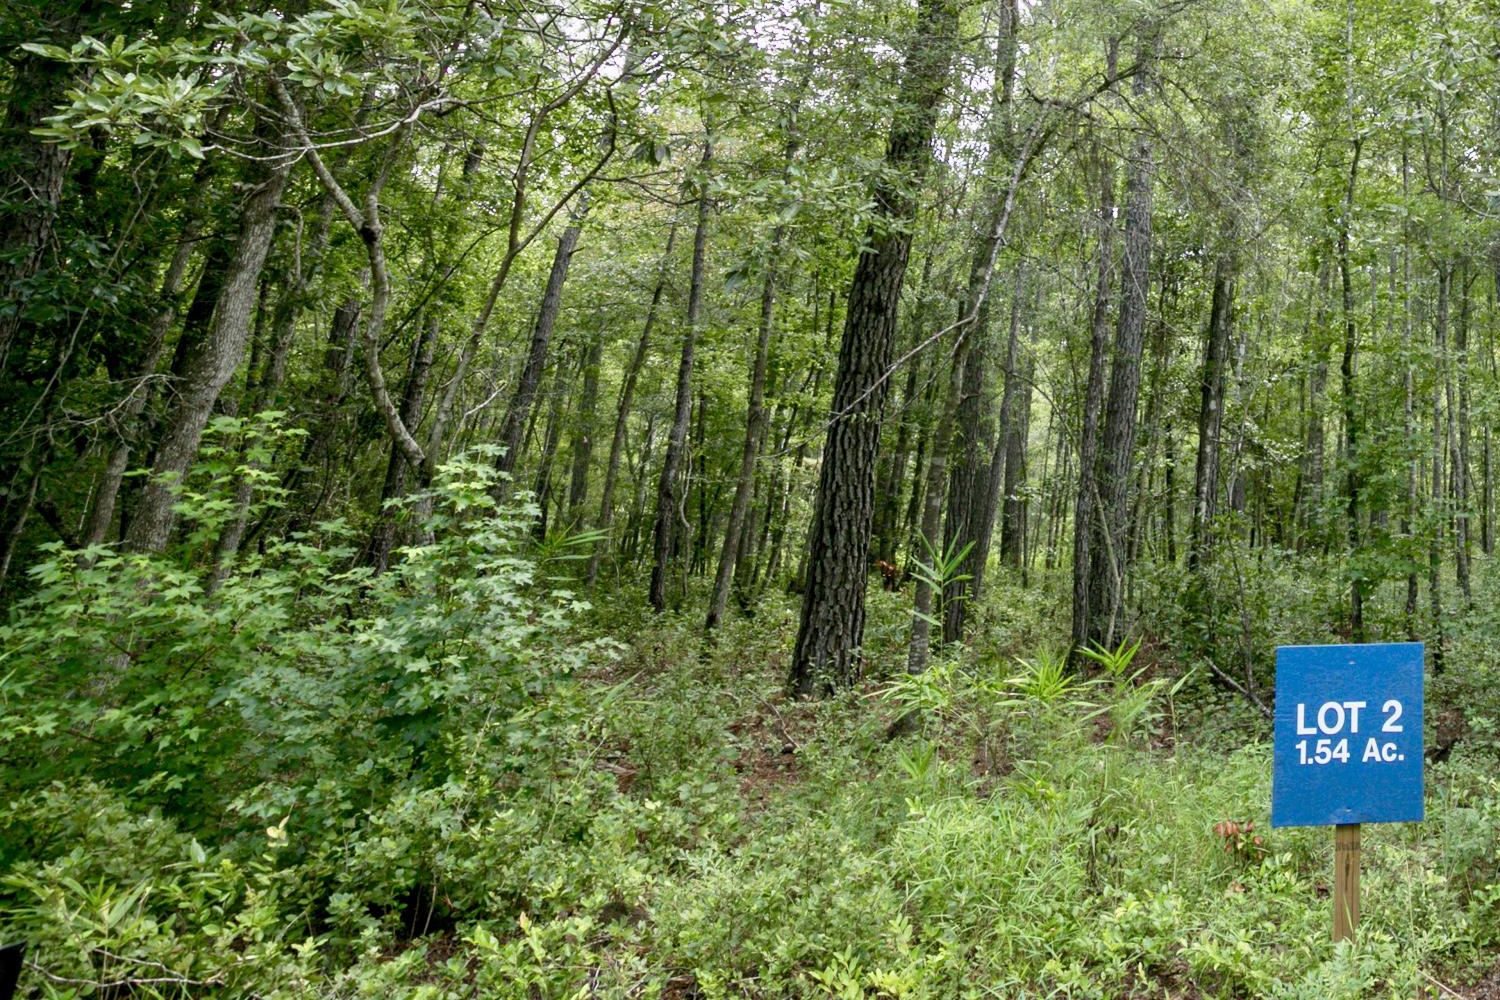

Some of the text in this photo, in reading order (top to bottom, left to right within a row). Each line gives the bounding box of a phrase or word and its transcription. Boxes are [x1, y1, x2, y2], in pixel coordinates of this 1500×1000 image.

[1296, 699, 1403, 735] LOT 2
[1295, 737, 1405, 765] 1.54 Ac.
